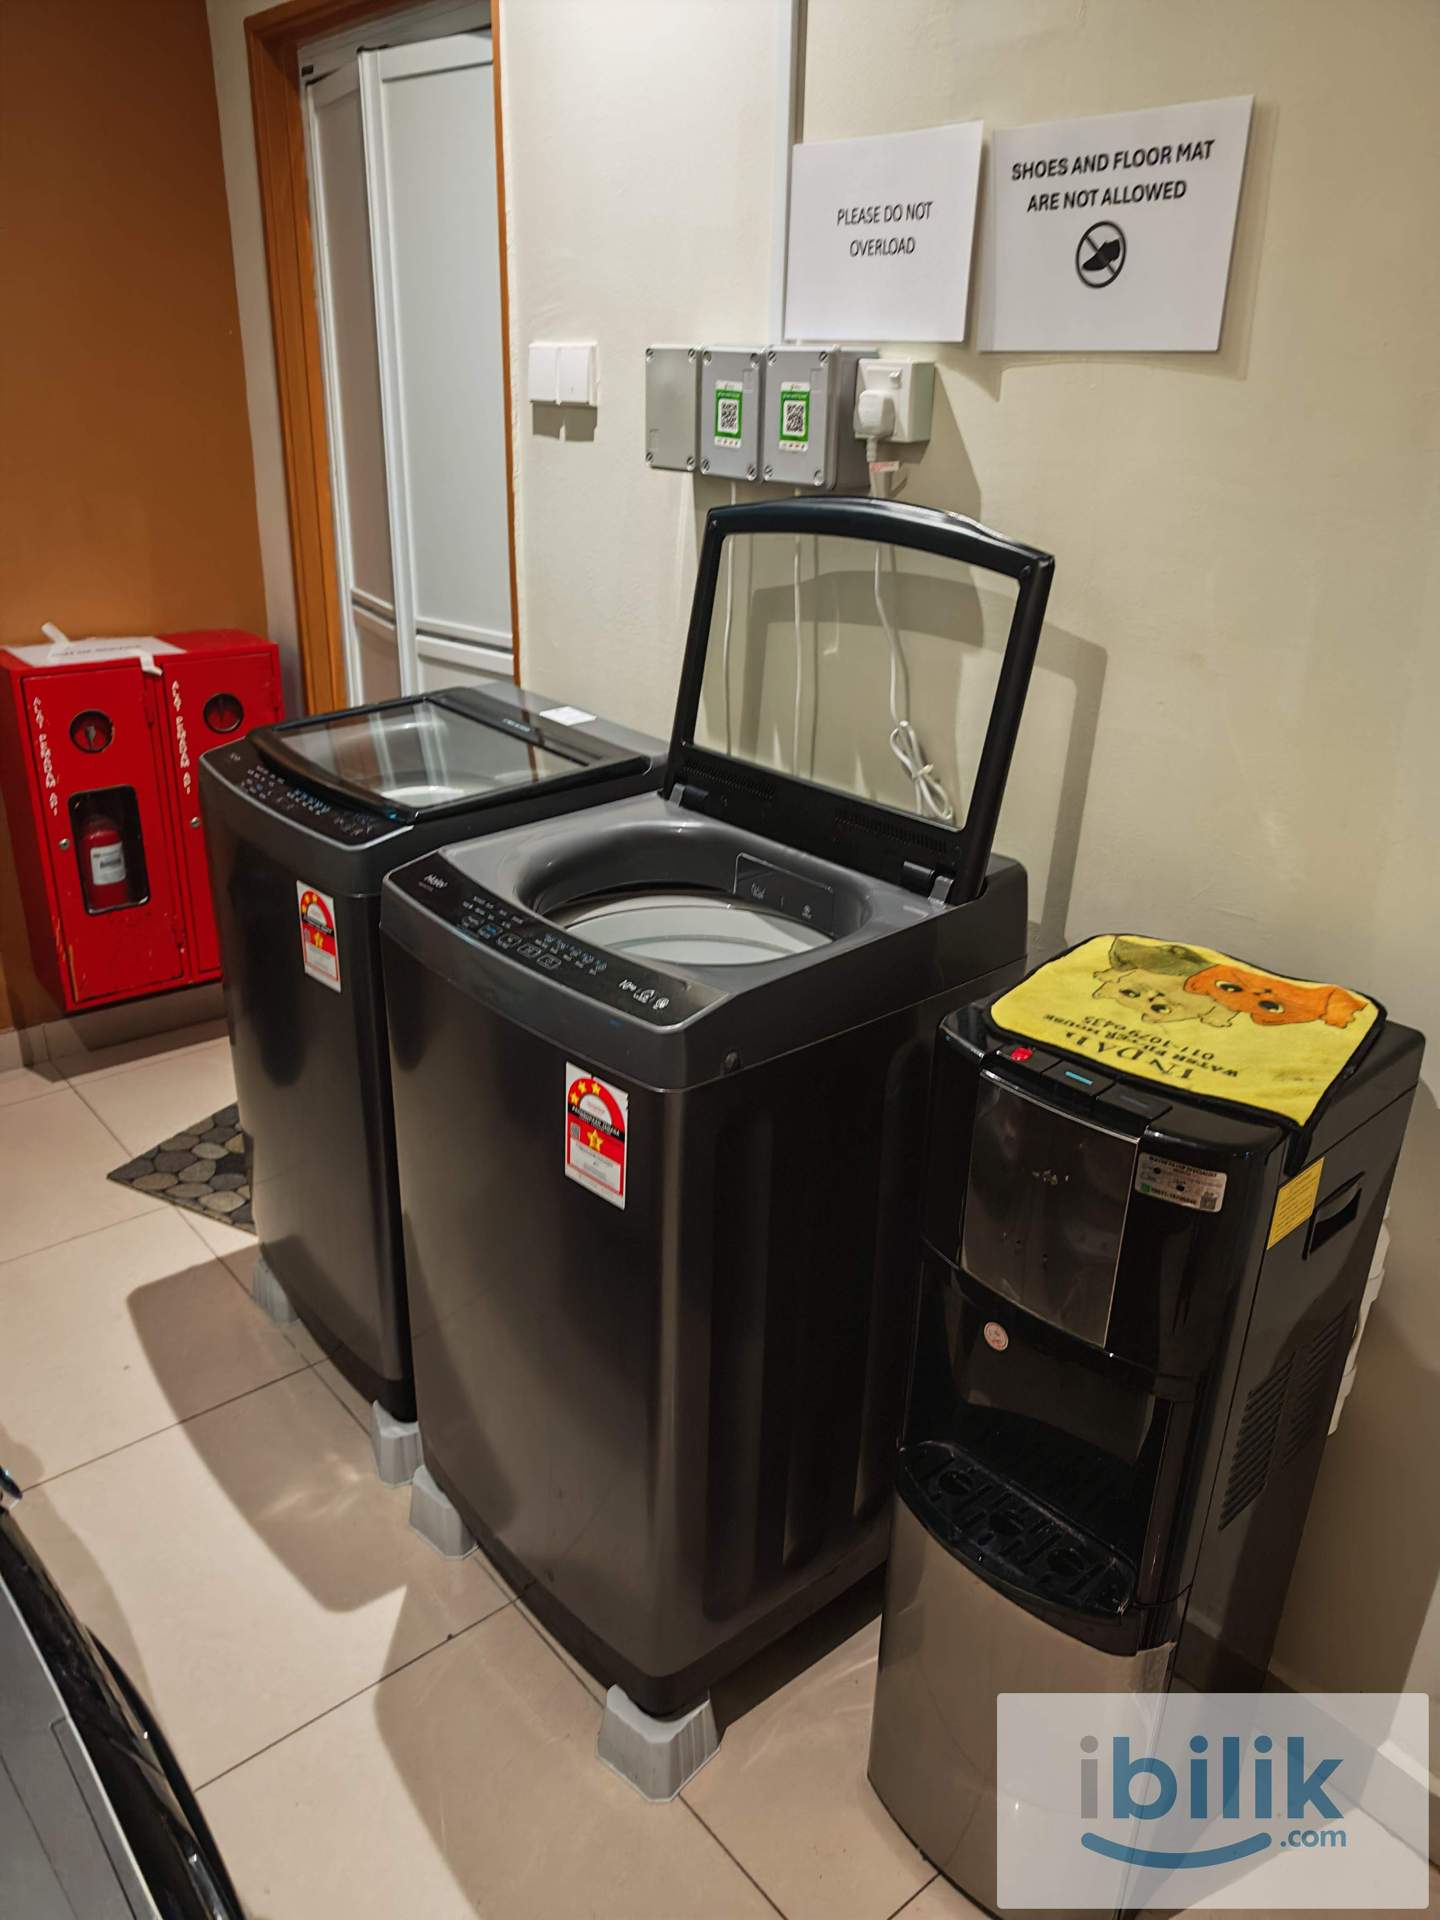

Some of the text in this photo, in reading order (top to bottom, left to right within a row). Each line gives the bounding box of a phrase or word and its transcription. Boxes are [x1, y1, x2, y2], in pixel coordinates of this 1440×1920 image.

[1011, 139, 1215, 182] SHOES AND FLOOR MAT
[1026, 180, 1187, 213] ARE NOT ALLOWED
[837, 201, 934, 227] PLEASE DO NOT
[849, 236, 916, 257] OVERLOAD
[1105, 1029, 1167, 1057] FILTER
[1172, 1053, 1239, 1078] WATER
